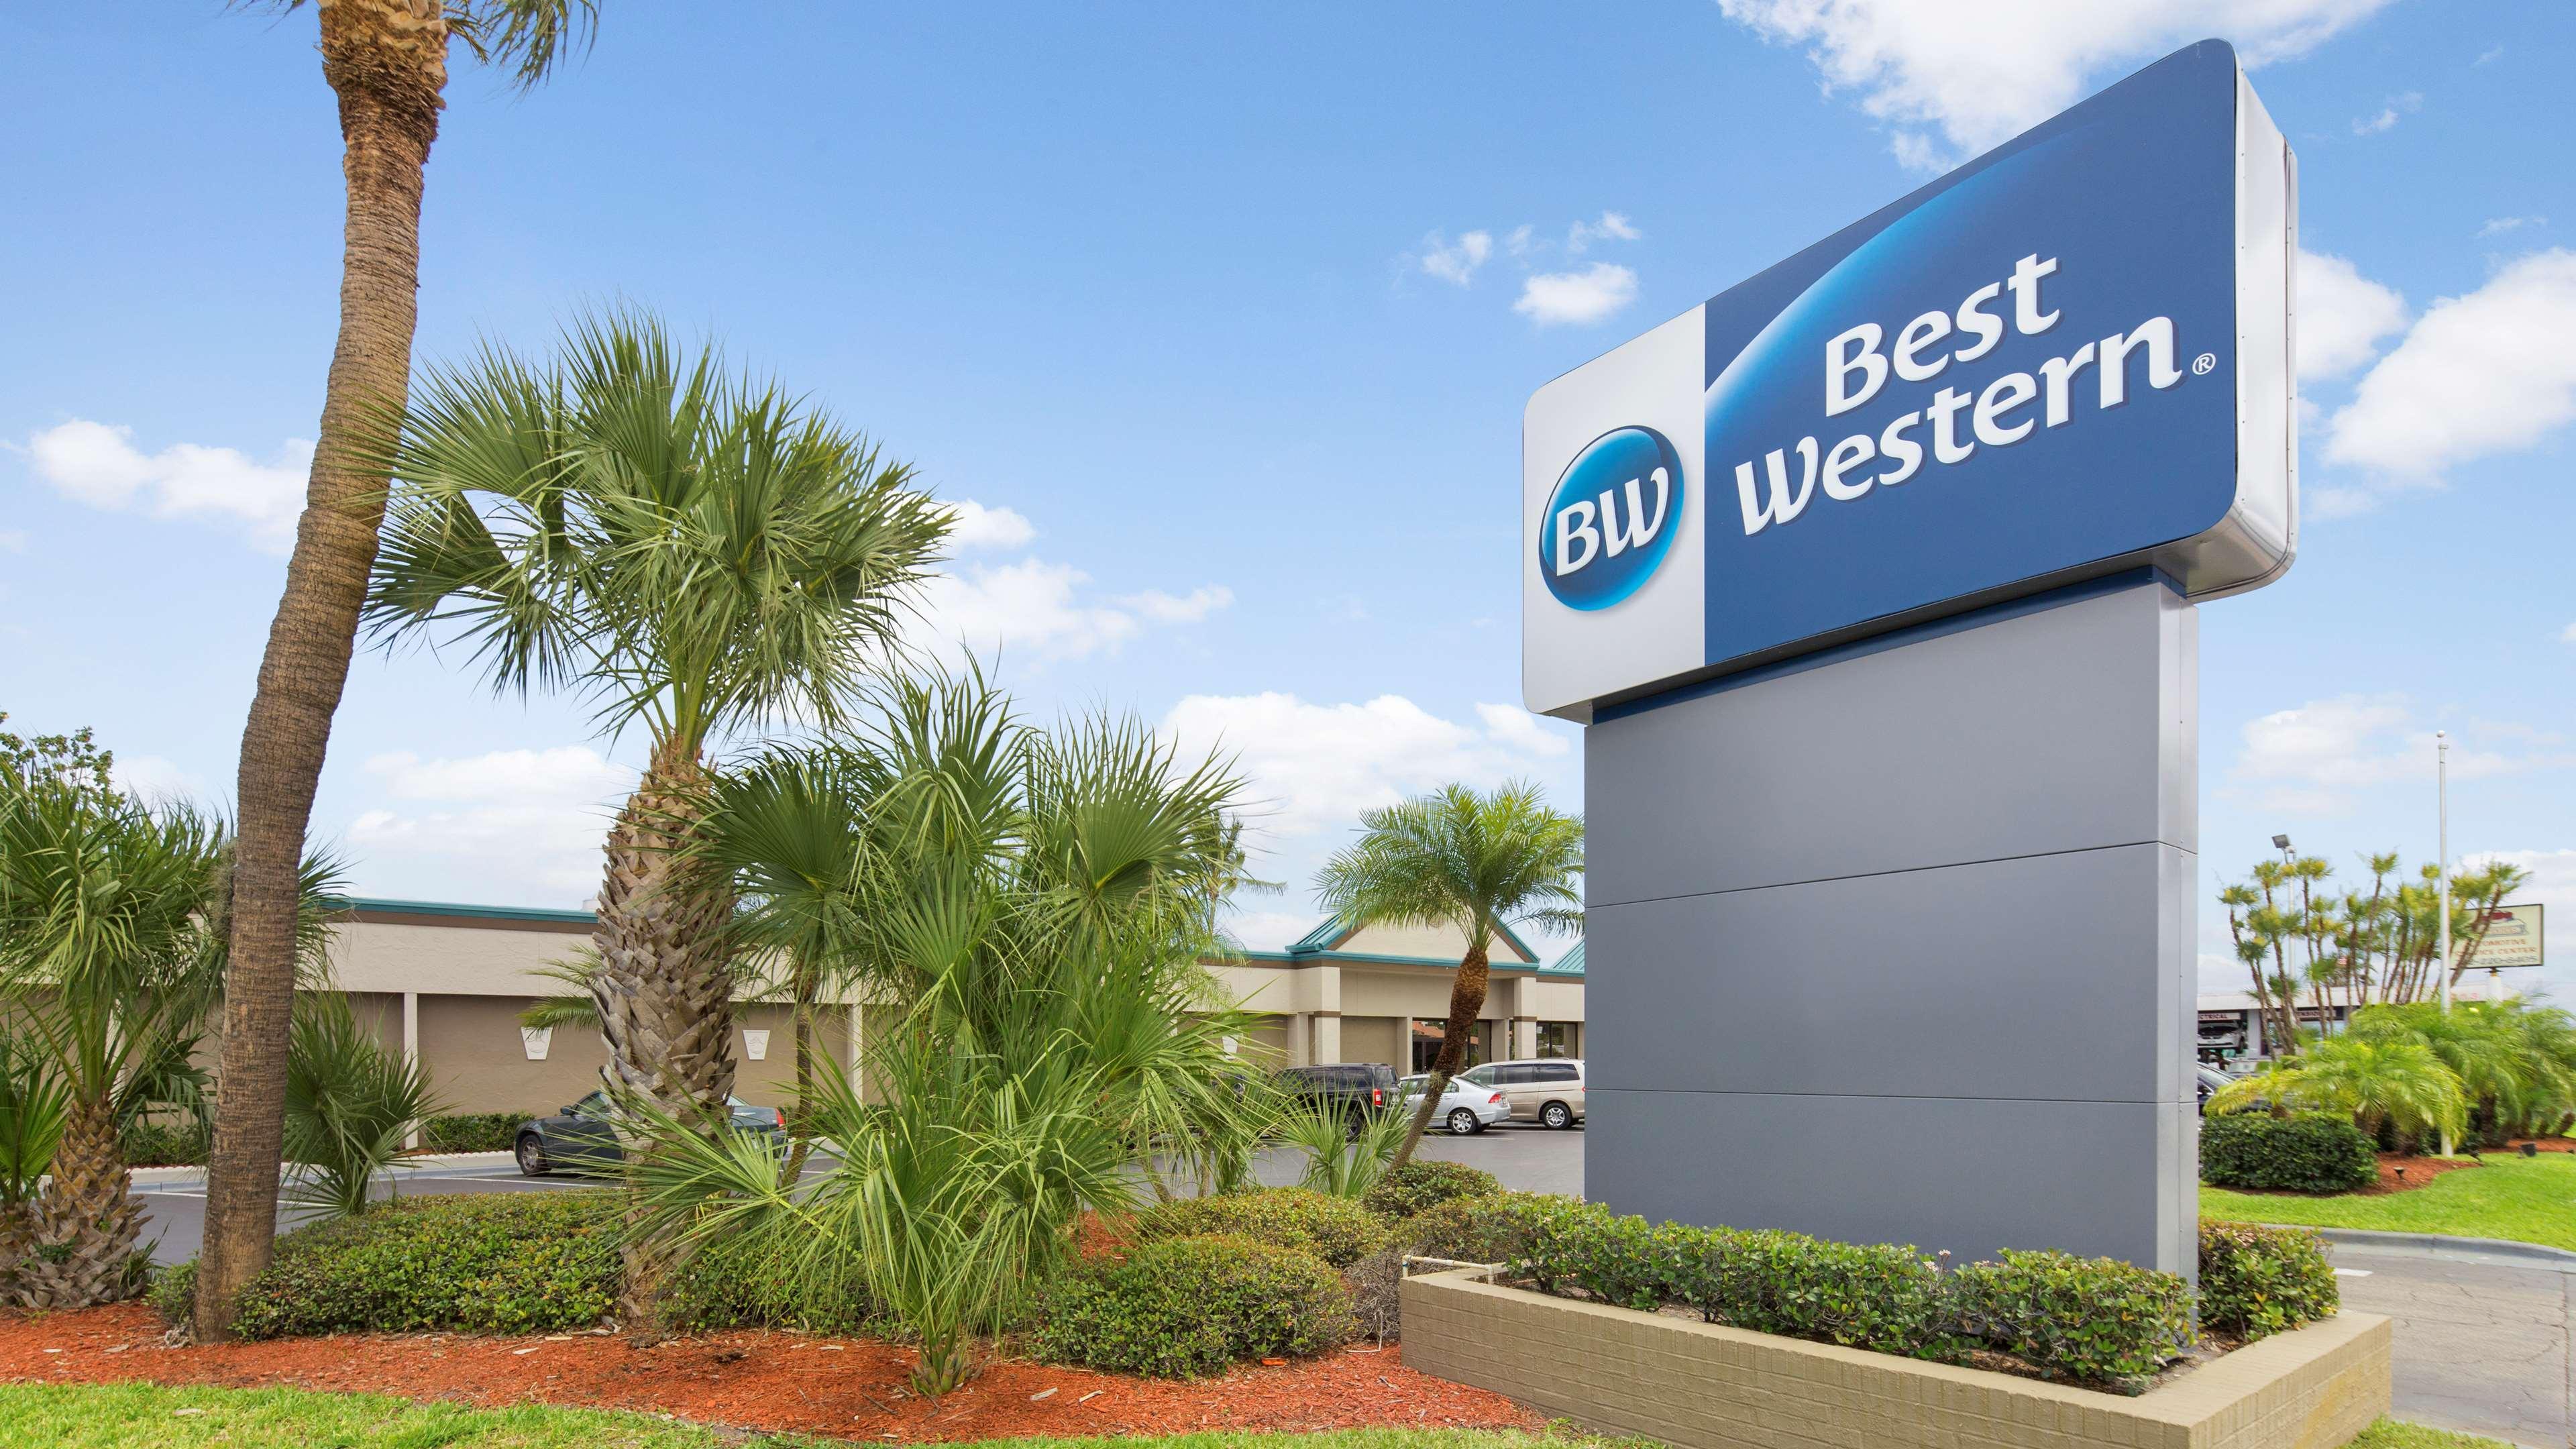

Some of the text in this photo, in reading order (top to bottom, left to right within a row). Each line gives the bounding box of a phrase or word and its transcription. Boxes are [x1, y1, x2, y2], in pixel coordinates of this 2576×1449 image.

[1826, 253, 2059, 417] Best
[1735, 316, 2182, 535] Western
[1556, 466, 1669, 576] BW
